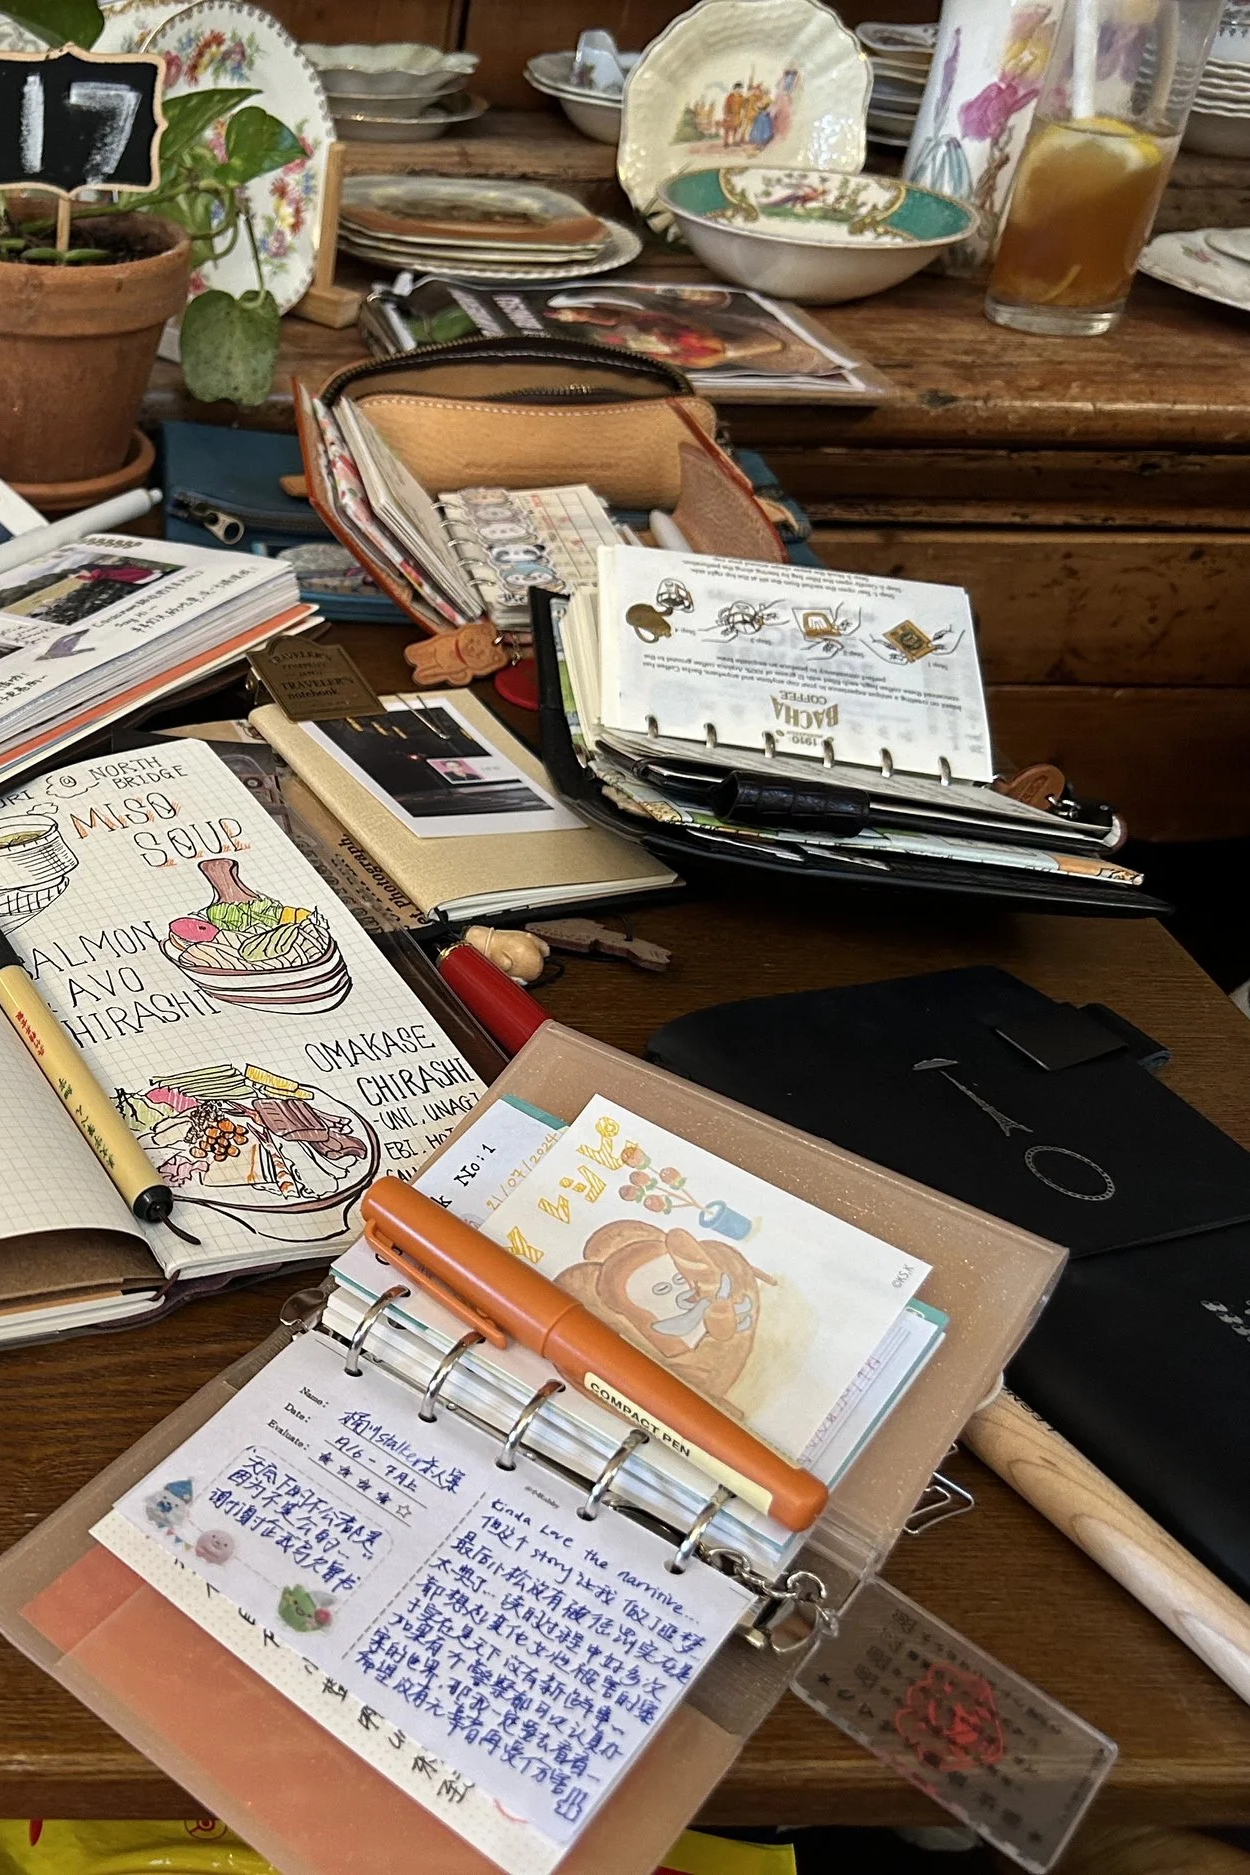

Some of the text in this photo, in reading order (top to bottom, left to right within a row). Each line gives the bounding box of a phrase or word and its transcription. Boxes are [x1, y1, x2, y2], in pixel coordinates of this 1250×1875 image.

[20, 73, 142, 184] 17
[287, 687, 337, 700] notebook
[779, 689, 827, 705] COFFEE
[771, 695, 840, 730] BACHA
[791, 734, 819, 746] 1910
[90, 755, 163, 783] NORTH
[112, 764, 189, 791] BRIDGE
[70, 791, 180, 840] MISO
[133, 817, 246, 868] SOUP
[68, 967, 145, 1008] AVO
[48, 989, 221, 1048] HIRASHI
[304, 1024, 436, 1073] OMAKASE
[356, 1057, 475, 1108] CHIRASHI
[487, 1132, 559, 1212] 21/07/2024
[283, 1402, 313, 1424] Date:
[299, 1386, 330, 1409] Name:
[267, 1417, 311, 1452] Evaluate:
[587, 1380, 692, 1458] COMPACT PEN
[530, 1548, 575, 1585] story
[584, 1546, 609, 1570] the
